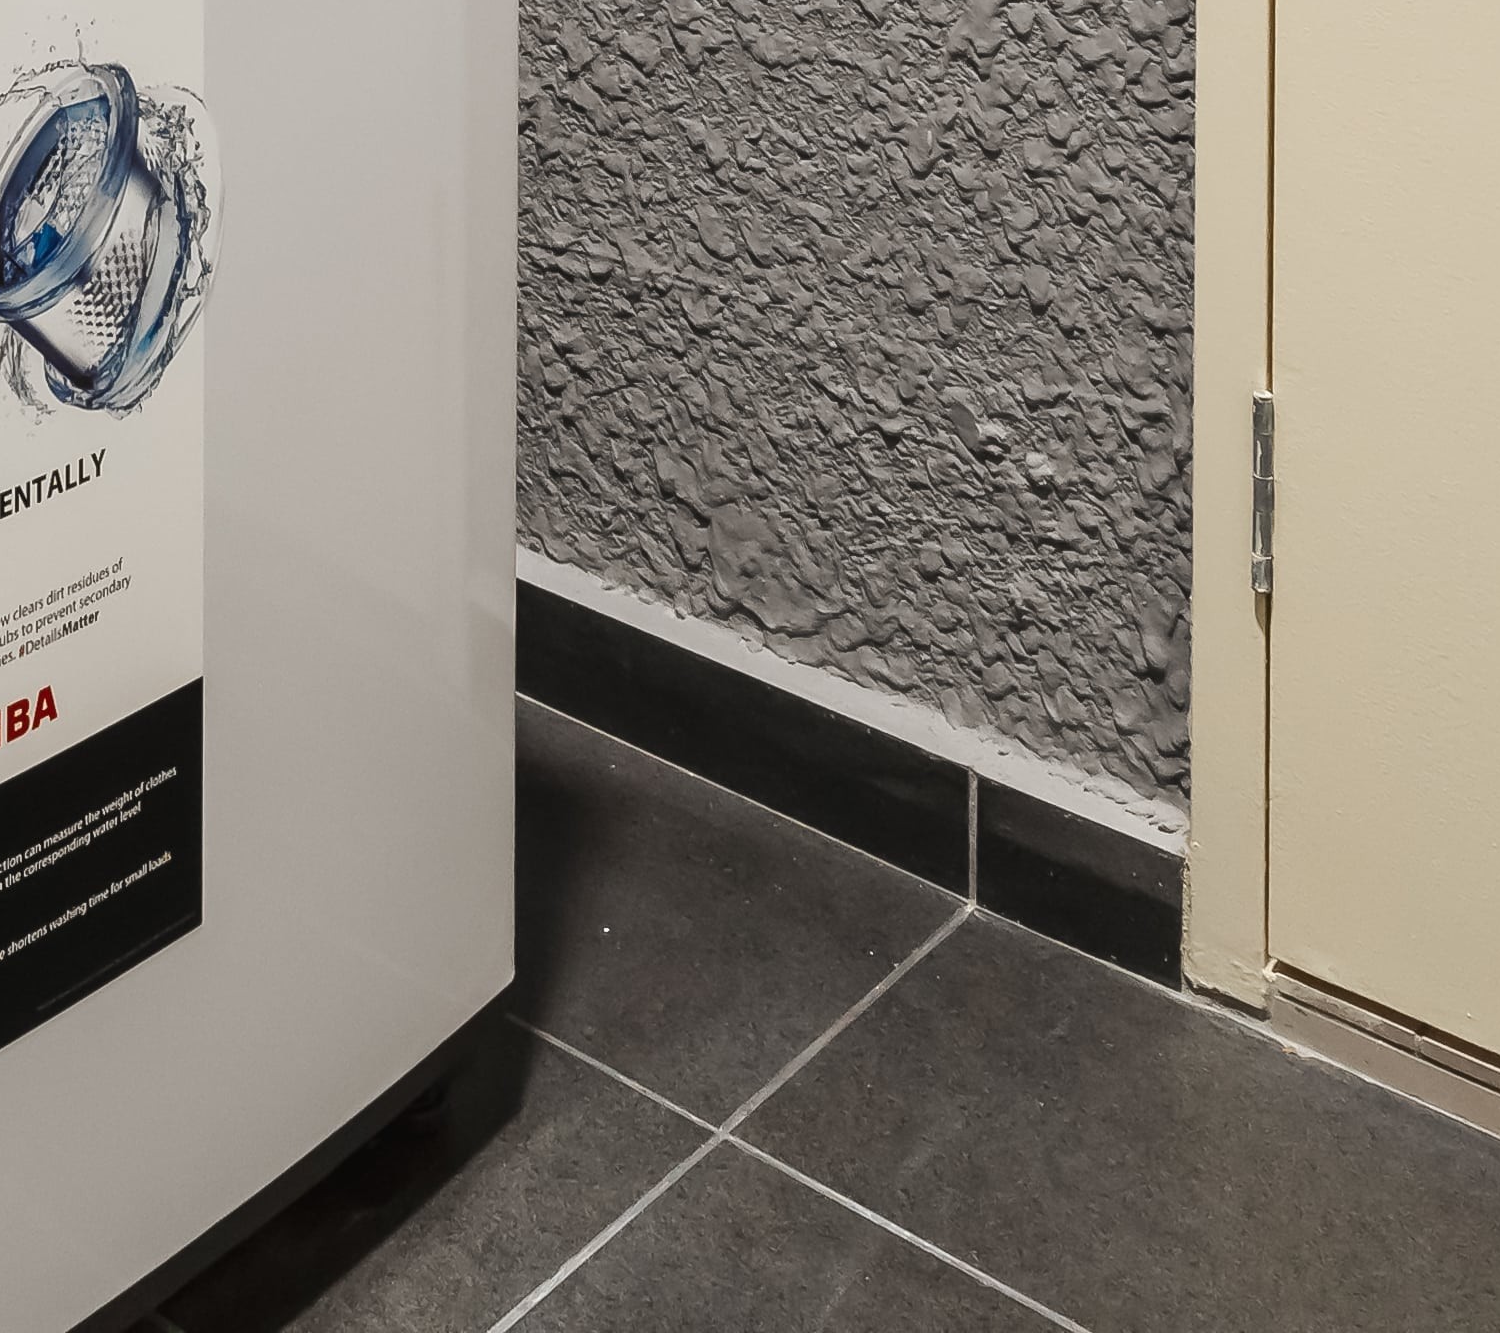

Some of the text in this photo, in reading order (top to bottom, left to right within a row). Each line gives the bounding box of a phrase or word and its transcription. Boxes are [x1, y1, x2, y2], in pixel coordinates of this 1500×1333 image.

[13, 599, 44, 621] clears
[46, 587, 64, 606] dirt
[67, 566, 110, 596] residues
[112, 557, 123, 575] of
[22, 623, 33, 637] to
[35, 601, 77, 633] prevent
[79, 575, 132, 608] secondary
[18, 611, 100, 658] #DetailsMatter
[5, 868, 22, 887] the
[23, 833, 91, 878] corresponding
[93, 818, 118, 839] water
[120, 801, 142, 823] level
[25, 843, 42, 860] can
[44, 821, 83, 849] measure
[85, 807, 100, 826] the
[102, 791, 132, 816] weight
[135, 781, 145, 797] of
[145, 766, 177, 791] clothes
[7, 924, 48, 956] shortens
[49, 902, 87, 931] washing
[89, 888, 109, 908] time
[110, 880, 123, 896] for
[124, 864, 148, 888] small
[148, 851, 172, 873] loads
